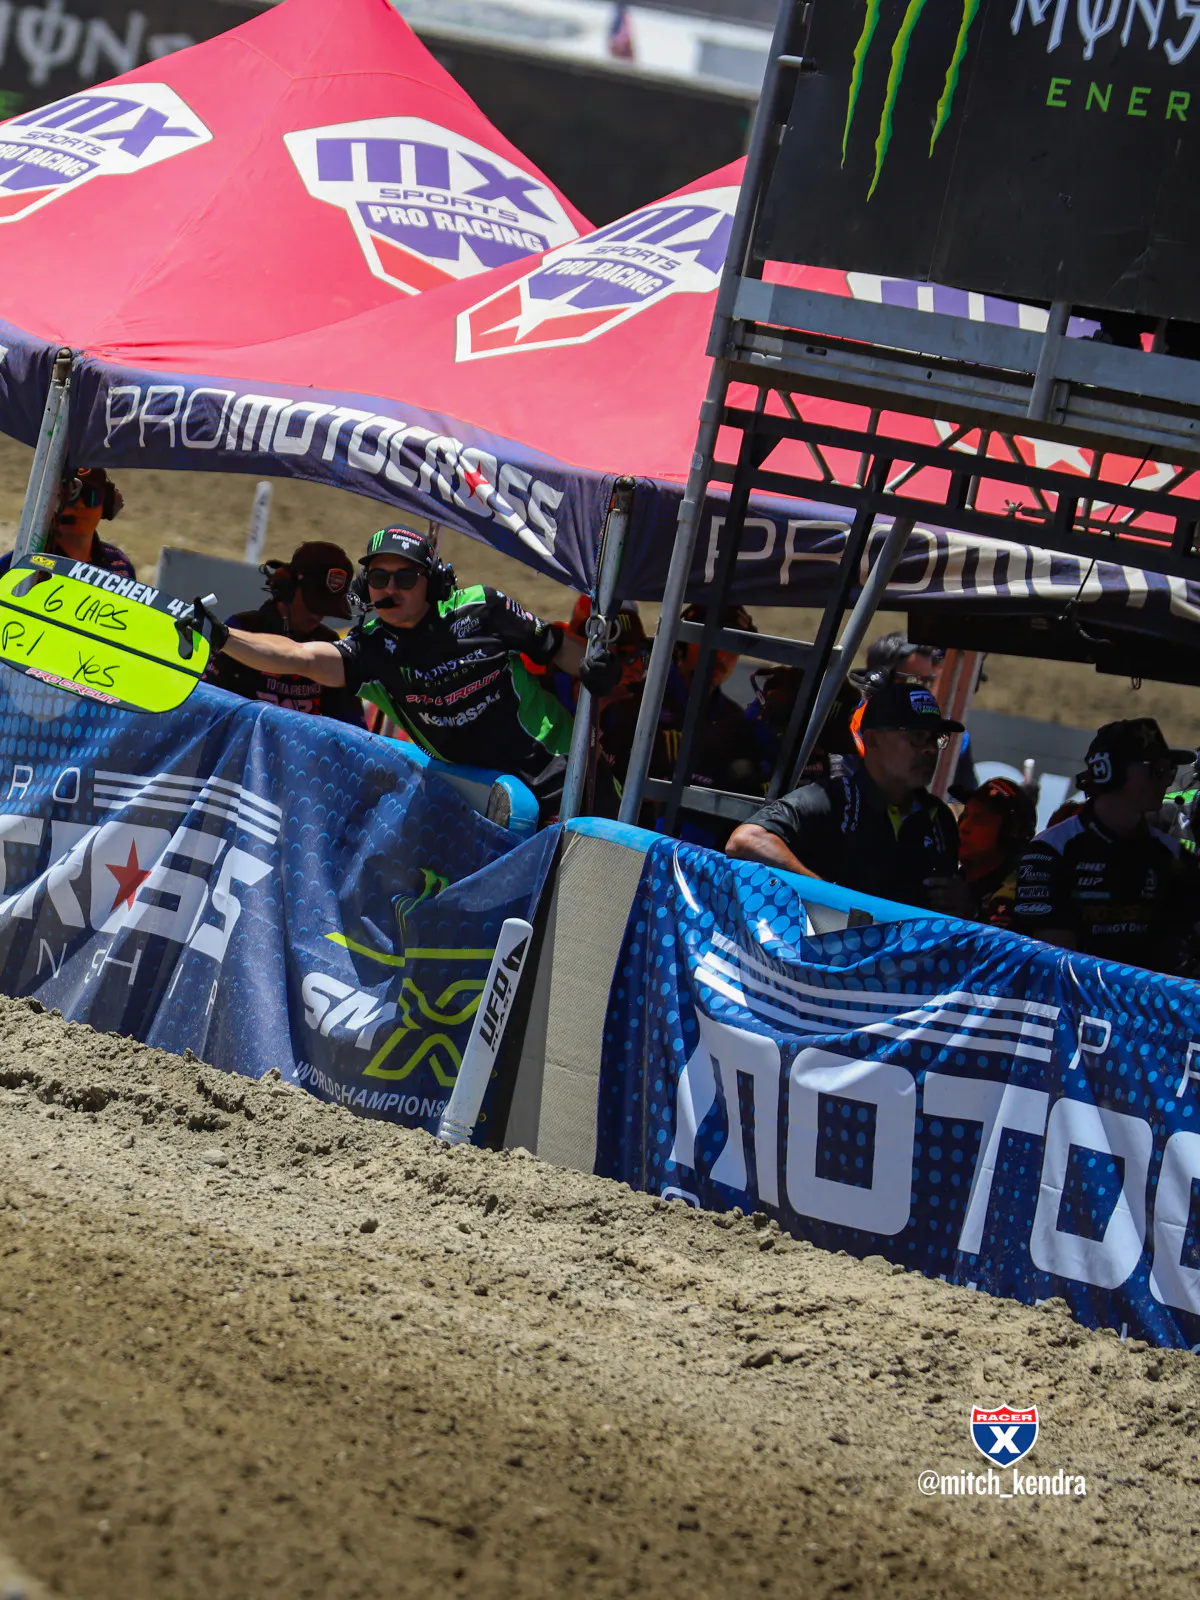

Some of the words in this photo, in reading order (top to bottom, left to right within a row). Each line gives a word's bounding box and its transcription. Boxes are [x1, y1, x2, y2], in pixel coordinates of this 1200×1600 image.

[1046, 77, 1191, 122] ENER
[20, 131, 106, 156] SPORTS
[23, 148, 89, 177] RACING
[379, 187, 520, 223] SPORTS
[367, 205, 429, 227] PRO
[433, 212, 545, 252] RACING
[588, 245, 681, 271] SPORTS
[544, 260, 593, 277] PRO
[588, 262, 664, 295] RACING
[43, 585, 65, 613] 6
[68, 561, 160, 606] KITCHEN
[25, 667, 60, 683] PRO
[58, 680, 121, 705] CIRCUIT
[479, 968, 509, 1048] UFO
[291, 1060, 335, 1097] WORLD
